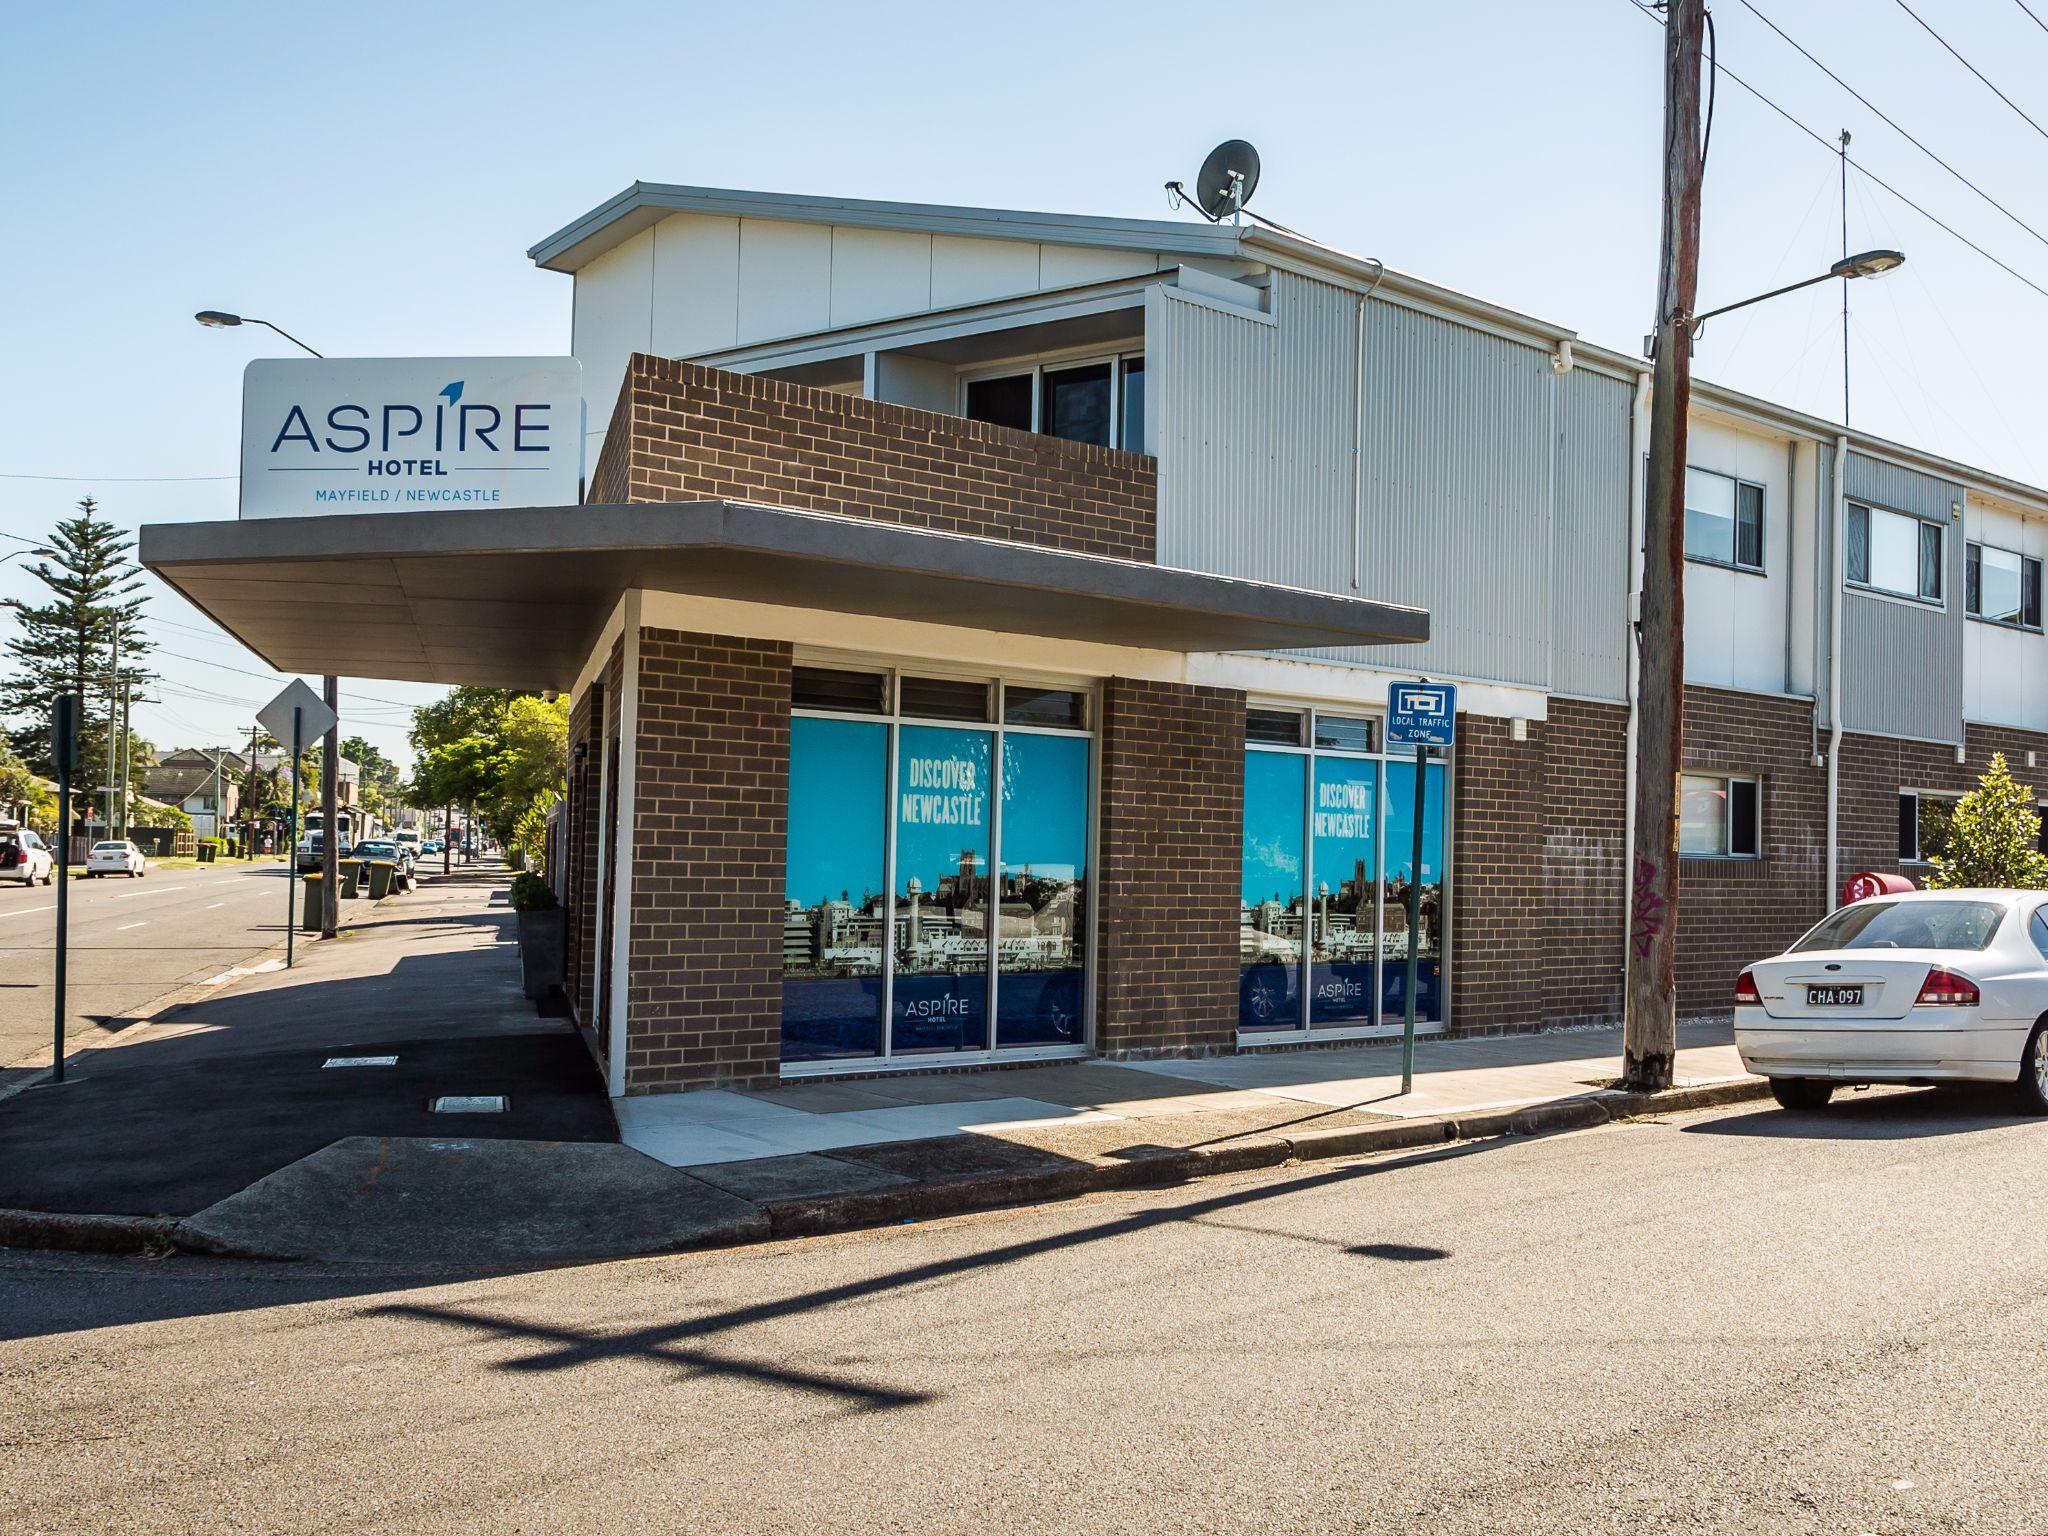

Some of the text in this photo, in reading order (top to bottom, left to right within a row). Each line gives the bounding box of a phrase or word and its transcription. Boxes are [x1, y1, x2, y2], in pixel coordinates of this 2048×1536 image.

[270, 403, 551, 453] ASPIRE
[367, 459, 448, 476] HOTEL
[315, 489, 501, 502] MAYFIELD / NEWCASTLE
[1392, 716, 1450, 728] LOCAL TRAFFIC
[1408, 729, 1432, 739] ZONE
[909, 757, 977, 791] DISCOVER
[1319, 782, 1366, 810] DISCOVER
[902, 793, 982, 826] NEWCASTLE
[1314, 812, 1370, 839] NEWCASTLE
[1317, 983, 1361, 997] ASPIRE
[1809, 990, 1861, 1004] CHA 097
[905, 999, 968, 1017] ASPIRE
